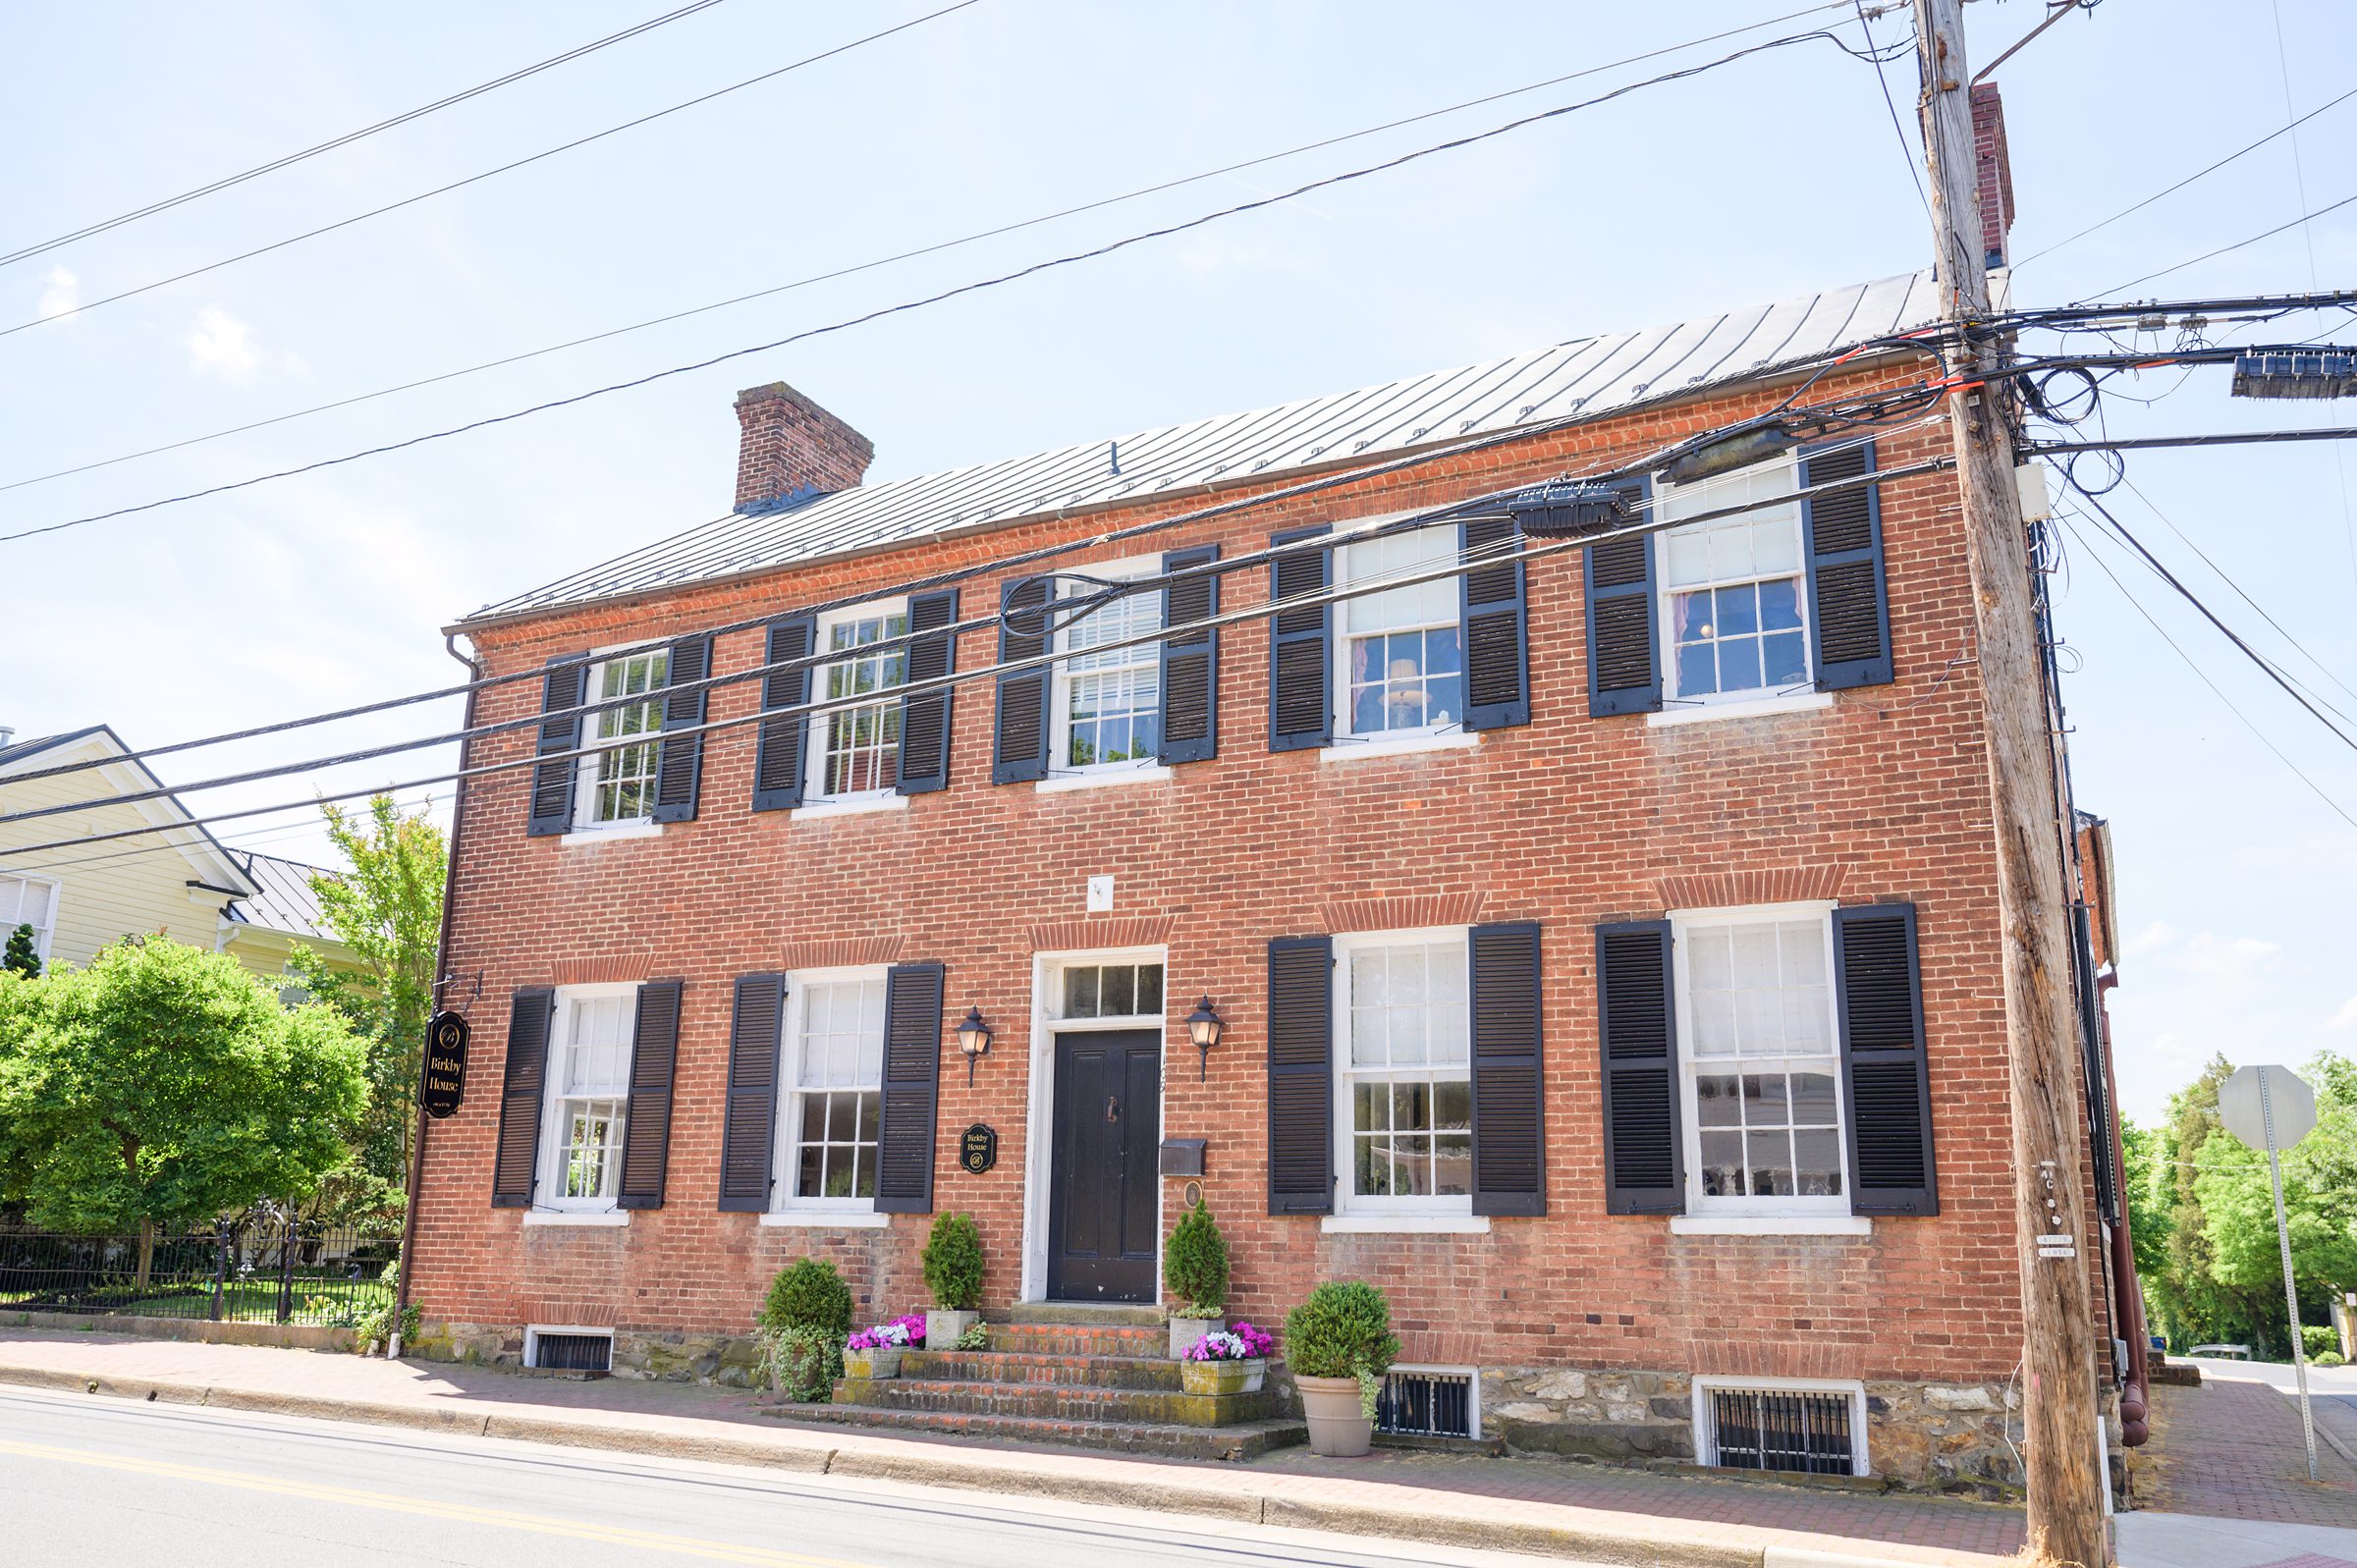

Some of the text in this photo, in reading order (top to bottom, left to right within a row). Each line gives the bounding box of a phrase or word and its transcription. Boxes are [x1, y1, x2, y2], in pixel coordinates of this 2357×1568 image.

[431, 1057, 462, 1075] Birkby
[429, 1077, 459, 1092] House
[967, 1134, 989, 1143] Birkby
